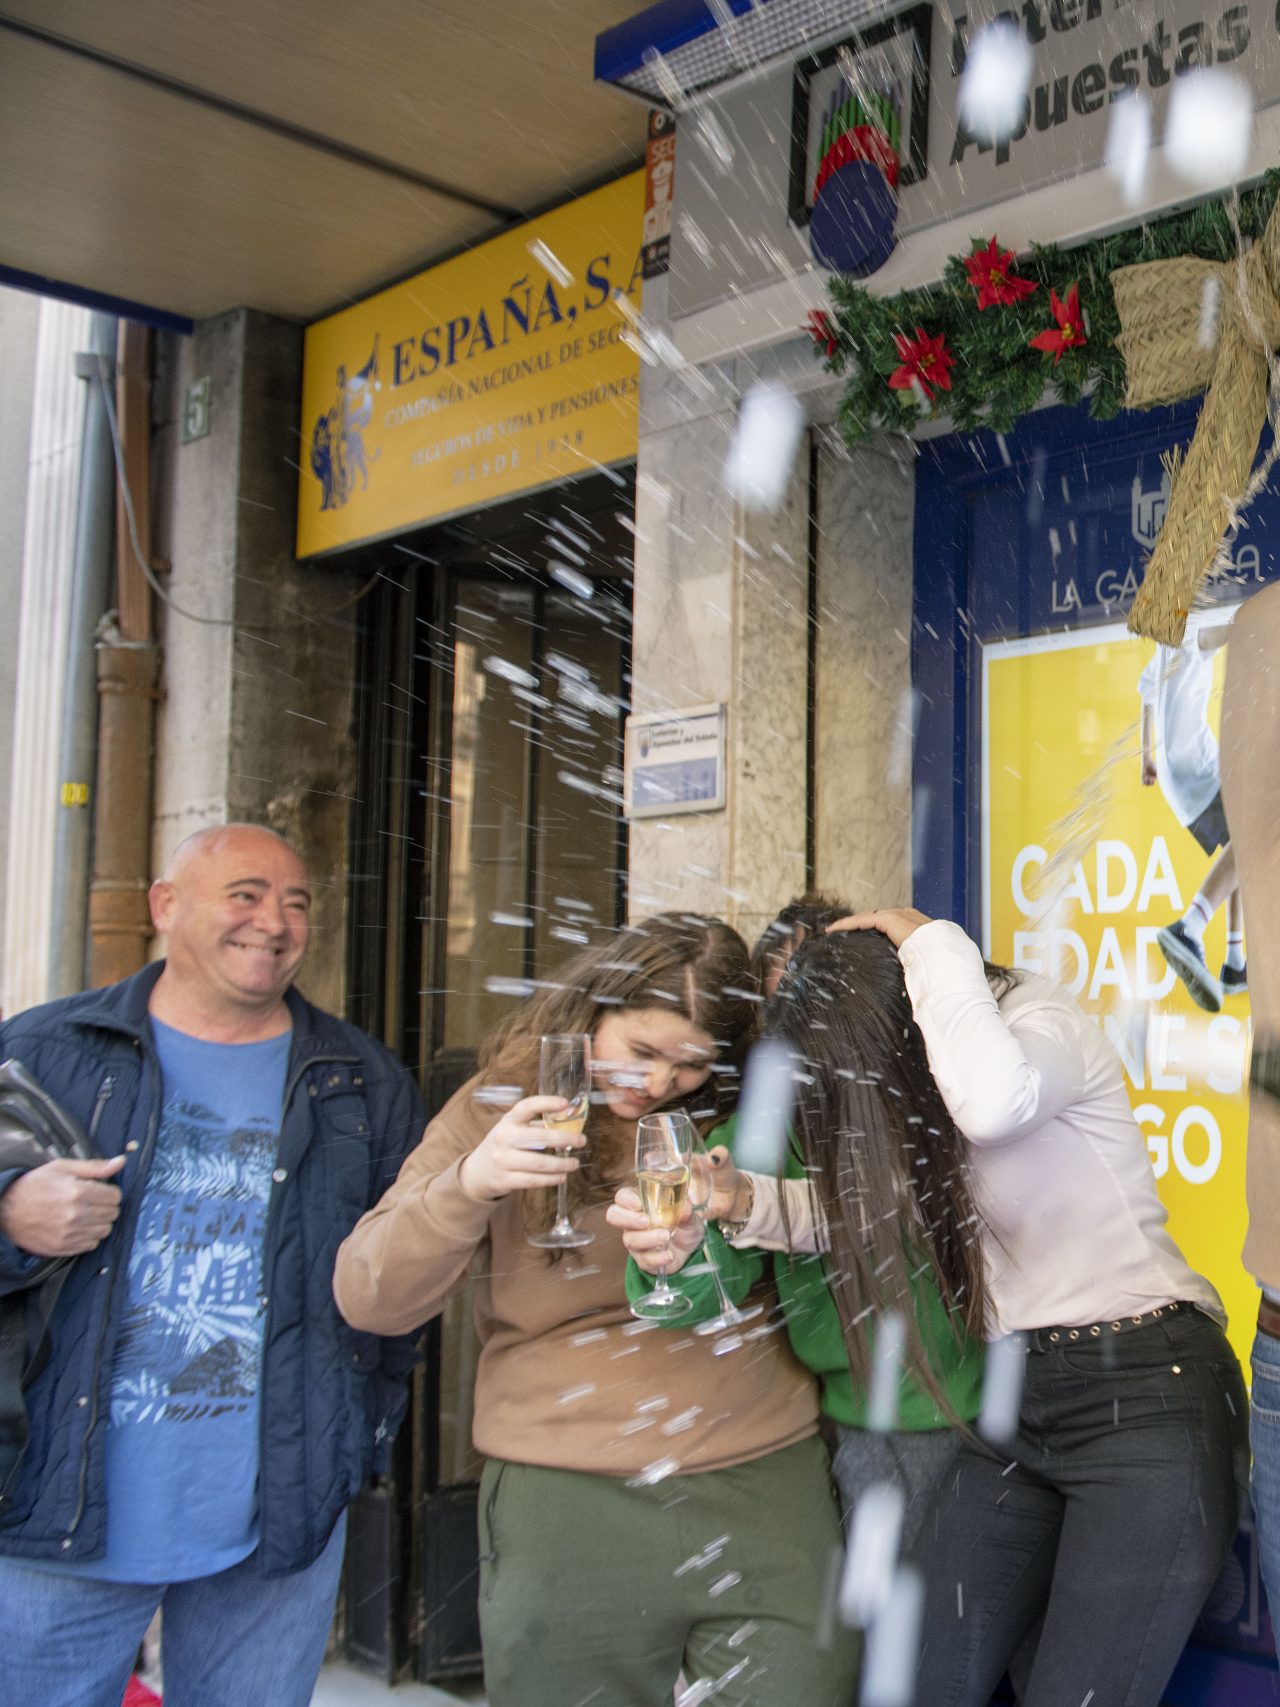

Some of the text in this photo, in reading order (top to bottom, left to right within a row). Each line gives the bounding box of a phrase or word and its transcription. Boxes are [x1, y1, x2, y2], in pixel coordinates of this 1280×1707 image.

[467, 352, 554, 397] NACIONAL
[559, 340, 583, 364] DE
[411, 374, 640, 468] SEGUROS DE VIDA Y PENSIONES
[453, 449, 520, 487] DESDE
[1011, 836, 1184, 918] CADA
[1013, 926, 1177, 1001] EDAD
